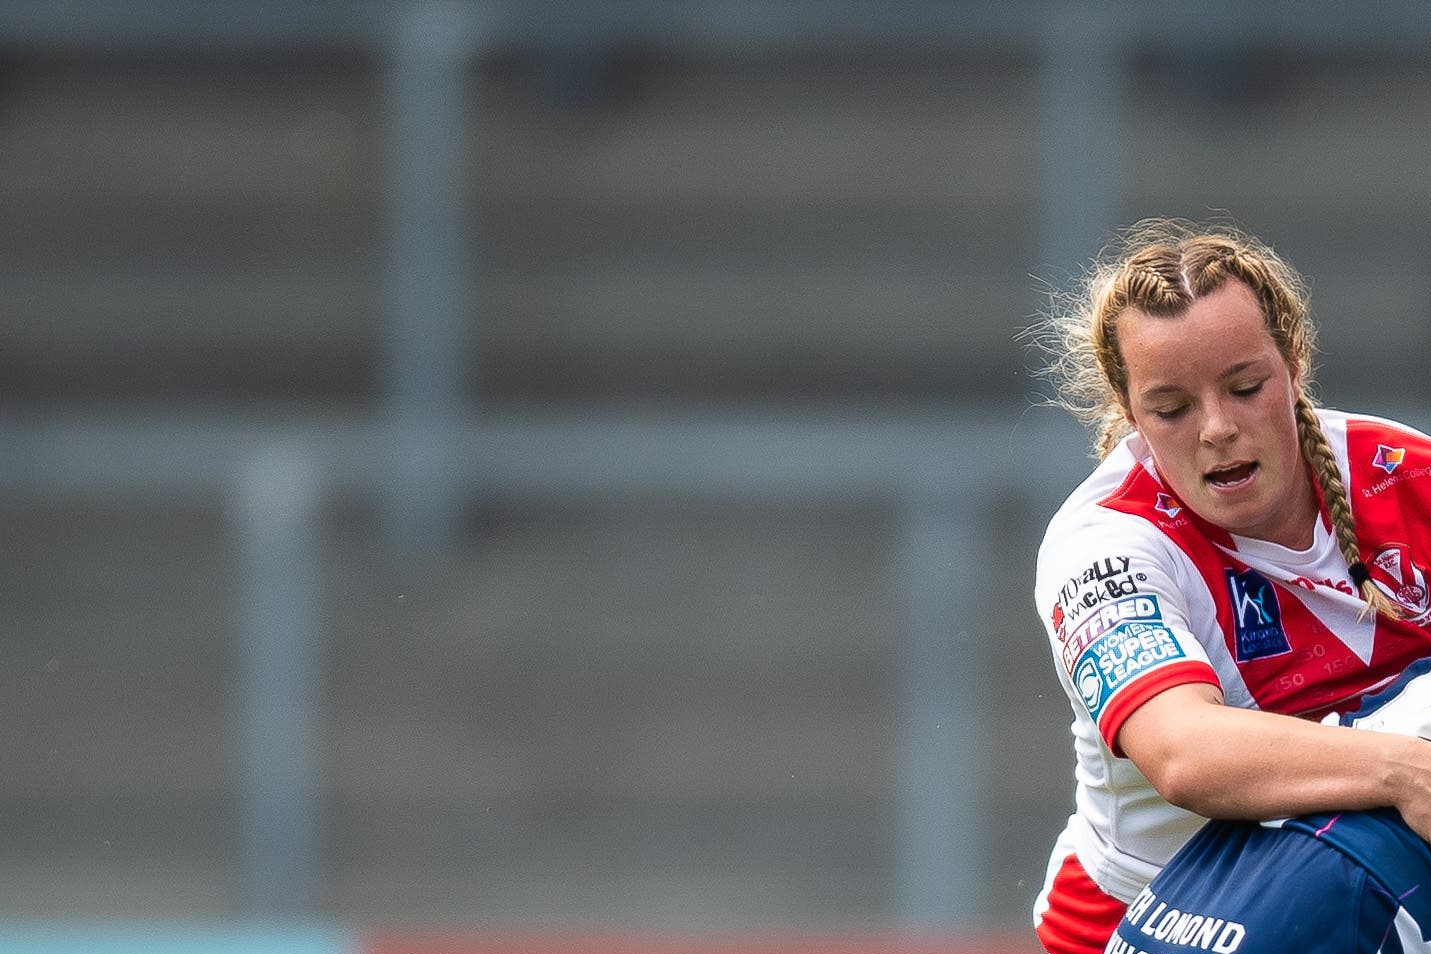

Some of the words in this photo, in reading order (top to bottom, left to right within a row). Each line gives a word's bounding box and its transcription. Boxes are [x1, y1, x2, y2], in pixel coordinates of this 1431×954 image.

[1064, 597, 1157, 672] BETFRED
[1099, 629, 1172, 676] SUPER
[1105, 644, 1179, 690] LEAGUE
